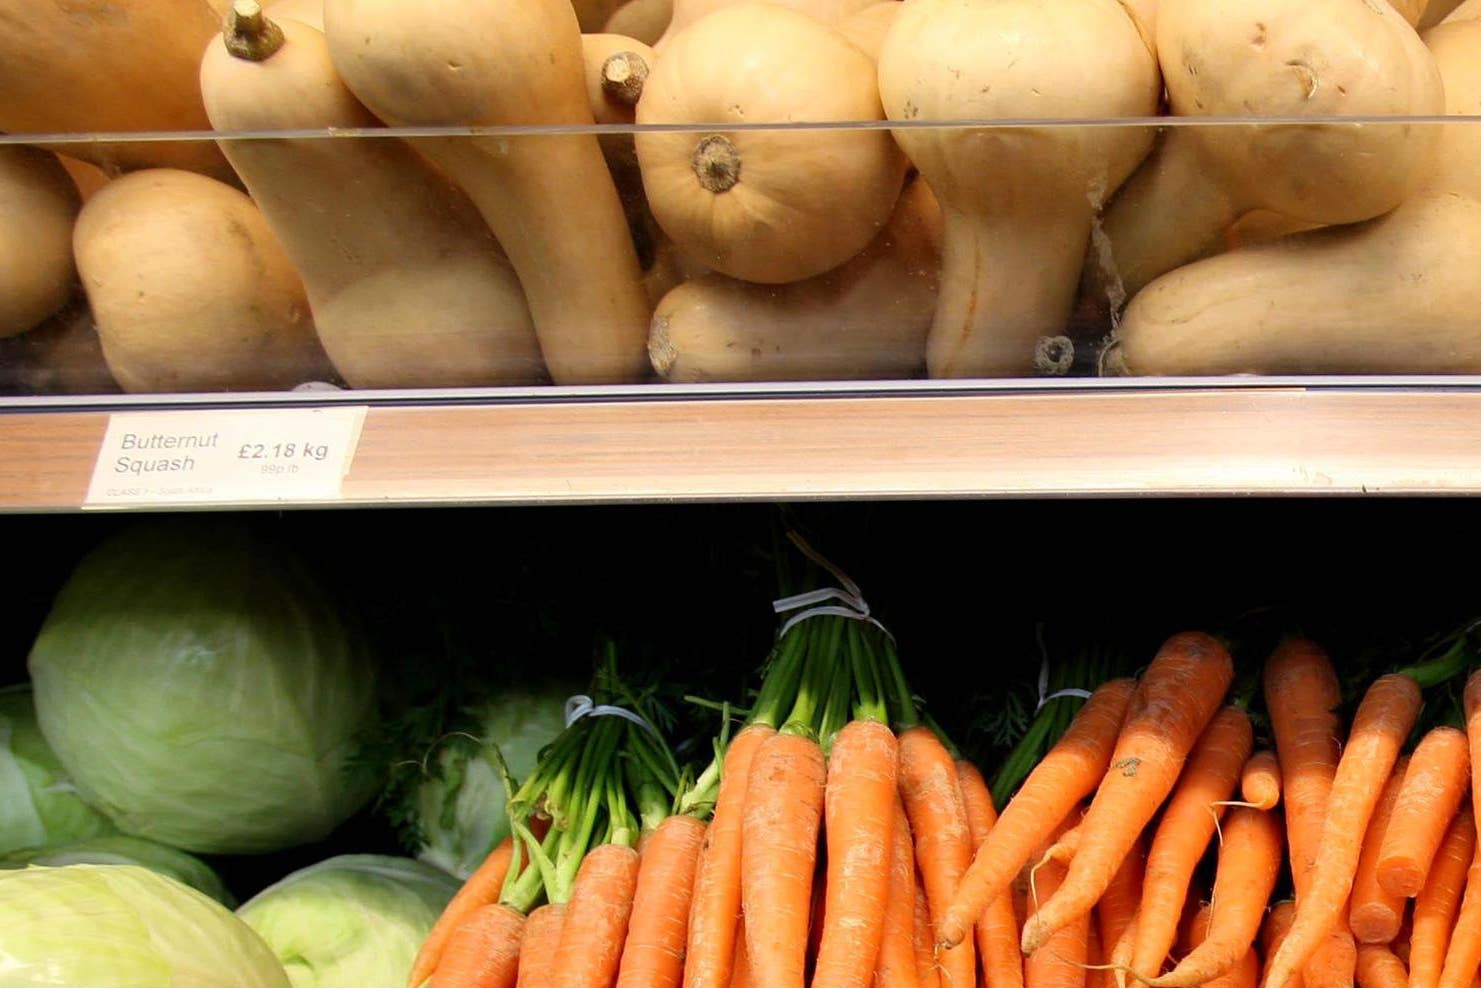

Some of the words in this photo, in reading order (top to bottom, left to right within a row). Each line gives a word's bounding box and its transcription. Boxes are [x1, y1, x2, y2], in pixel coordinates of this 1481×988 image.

[121, 432, 219, 450] Butternut
[237, 443, 296, 459] £2.18
[303, 441, 329, 461] kg
[114, 455, 195, 476] Squash
